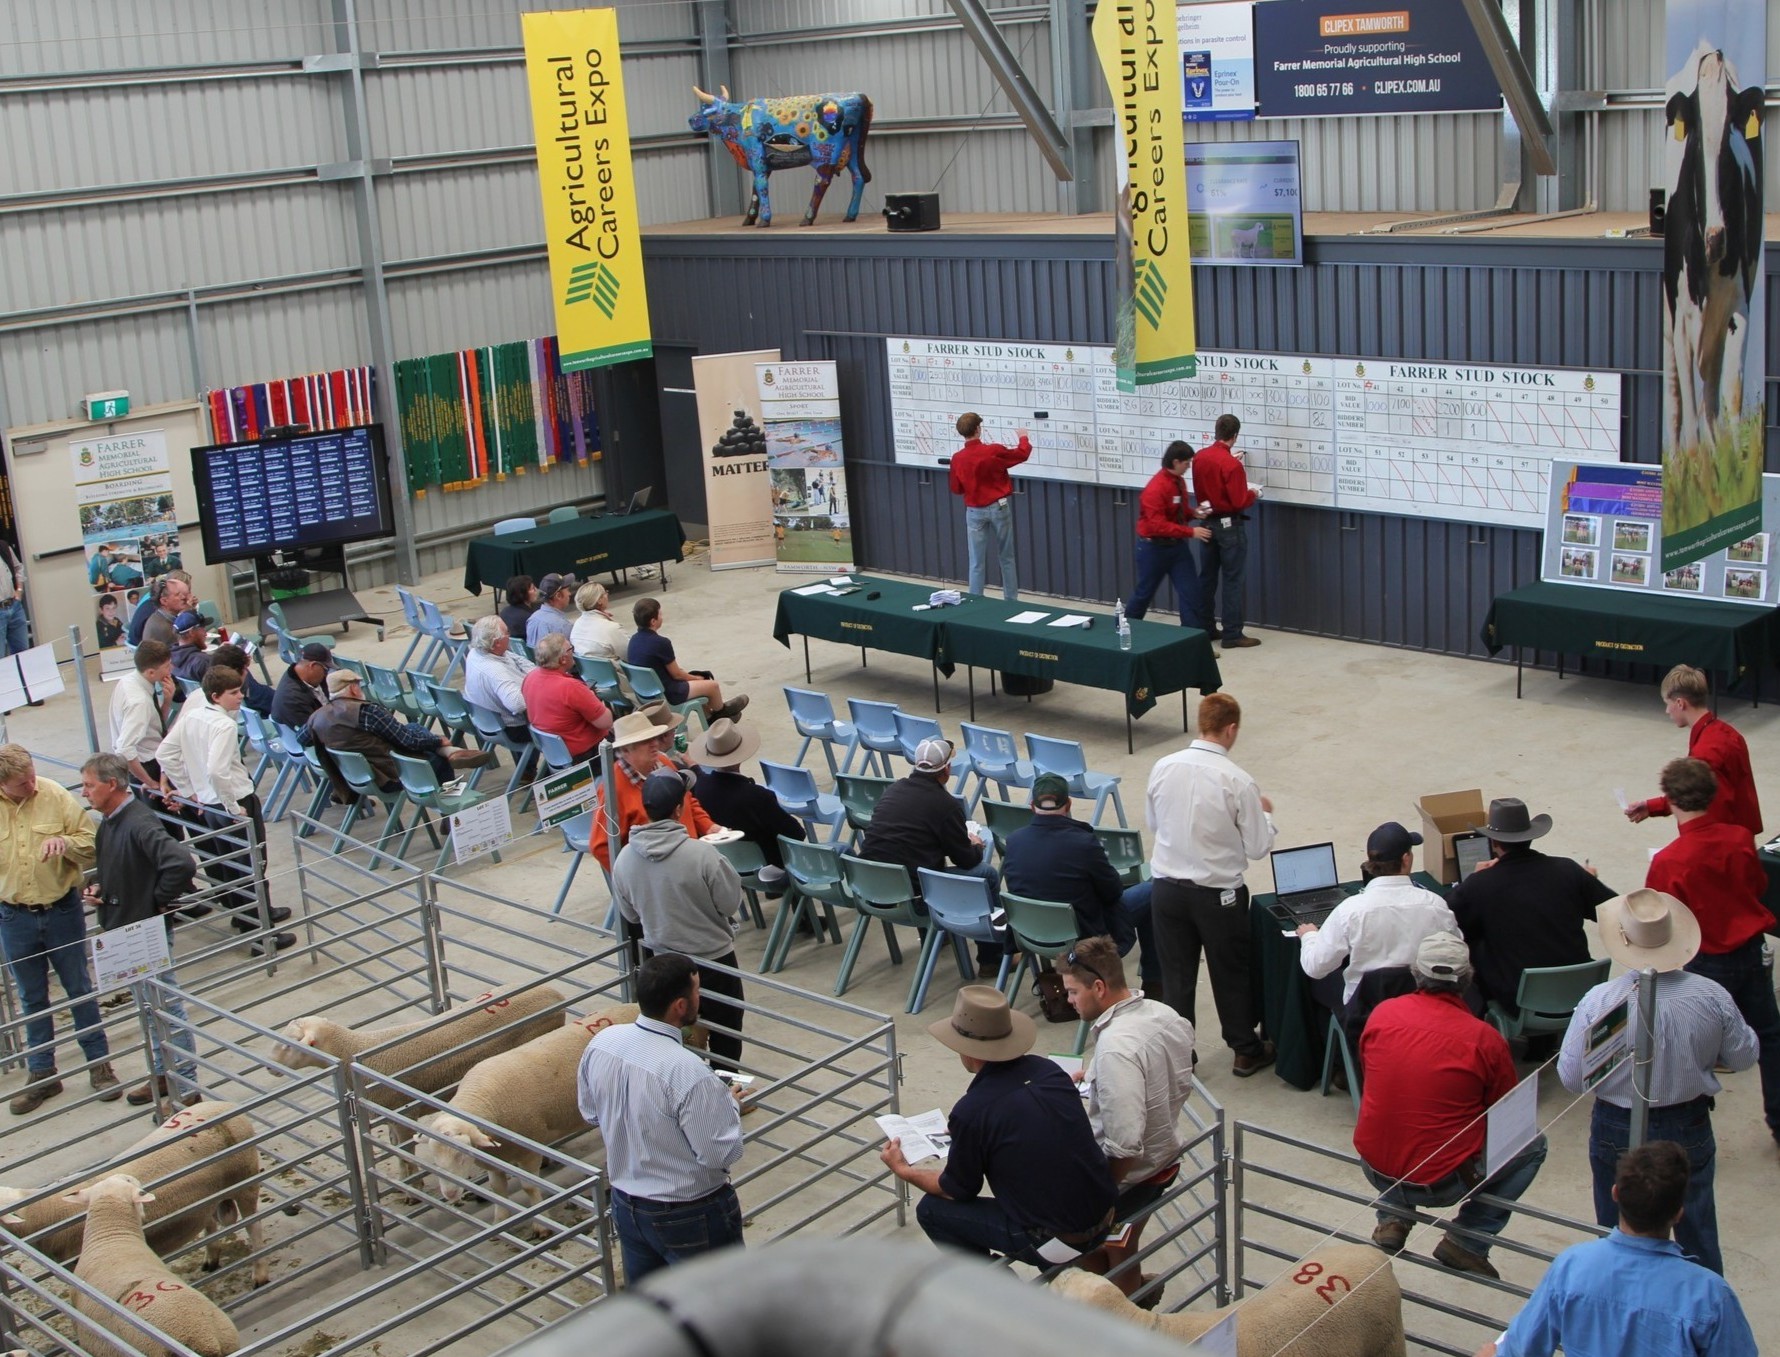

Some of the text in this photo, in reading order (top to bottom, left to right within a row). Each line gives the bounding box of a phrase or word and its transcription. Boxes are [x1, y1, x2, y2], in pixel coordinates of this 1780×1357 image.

[1324, 16, 1404, 33] CLIPEX TAMWORTH
[1202, 36, 1225, 45] parasite
[1324, 41, 1405, 54] Proudly supporting
[1274, 52, 1461, 71] Farrer Memorial Agricultural High School
[1214, 71, 1237, 79] Eprinex
[1214, 79, 1240, 87] Pour-On
[1294, 82, 1353, 98] 1800 65 77 66
[1374, 79, 1441, 94] CLIPEX.COM.AU
[1143, 0, 1169, 257] Careers Expo
[547, 55, 596, 252] Agricultural
[584, 48, 621, 260] Careers Expo
[927, 343, 1045, 359] FARRER STUD STOCK
[1195, 356, 1279, 370] STUD STOCK
[778, 367, 820, 376] FARRER
[1390, 365, 1555, 386] FARRER STUD STOCK
[97, 439, 146, 453] FARRER
[98, 450, 140, 462] MEMORIAL
[99, 456, 158, 470] AGRICULTURAL
[100, 465, 153, 479] HIGH SCHOOL
[105, 479, 142, 490] BOARDING
[1338, 478, 1365, 486] BIDDERS
[1338, 485, 1365, 493] NUMBER
[548, 783, 567, 795] FARRER
[1293, 1262, 1351, 1305] 38
